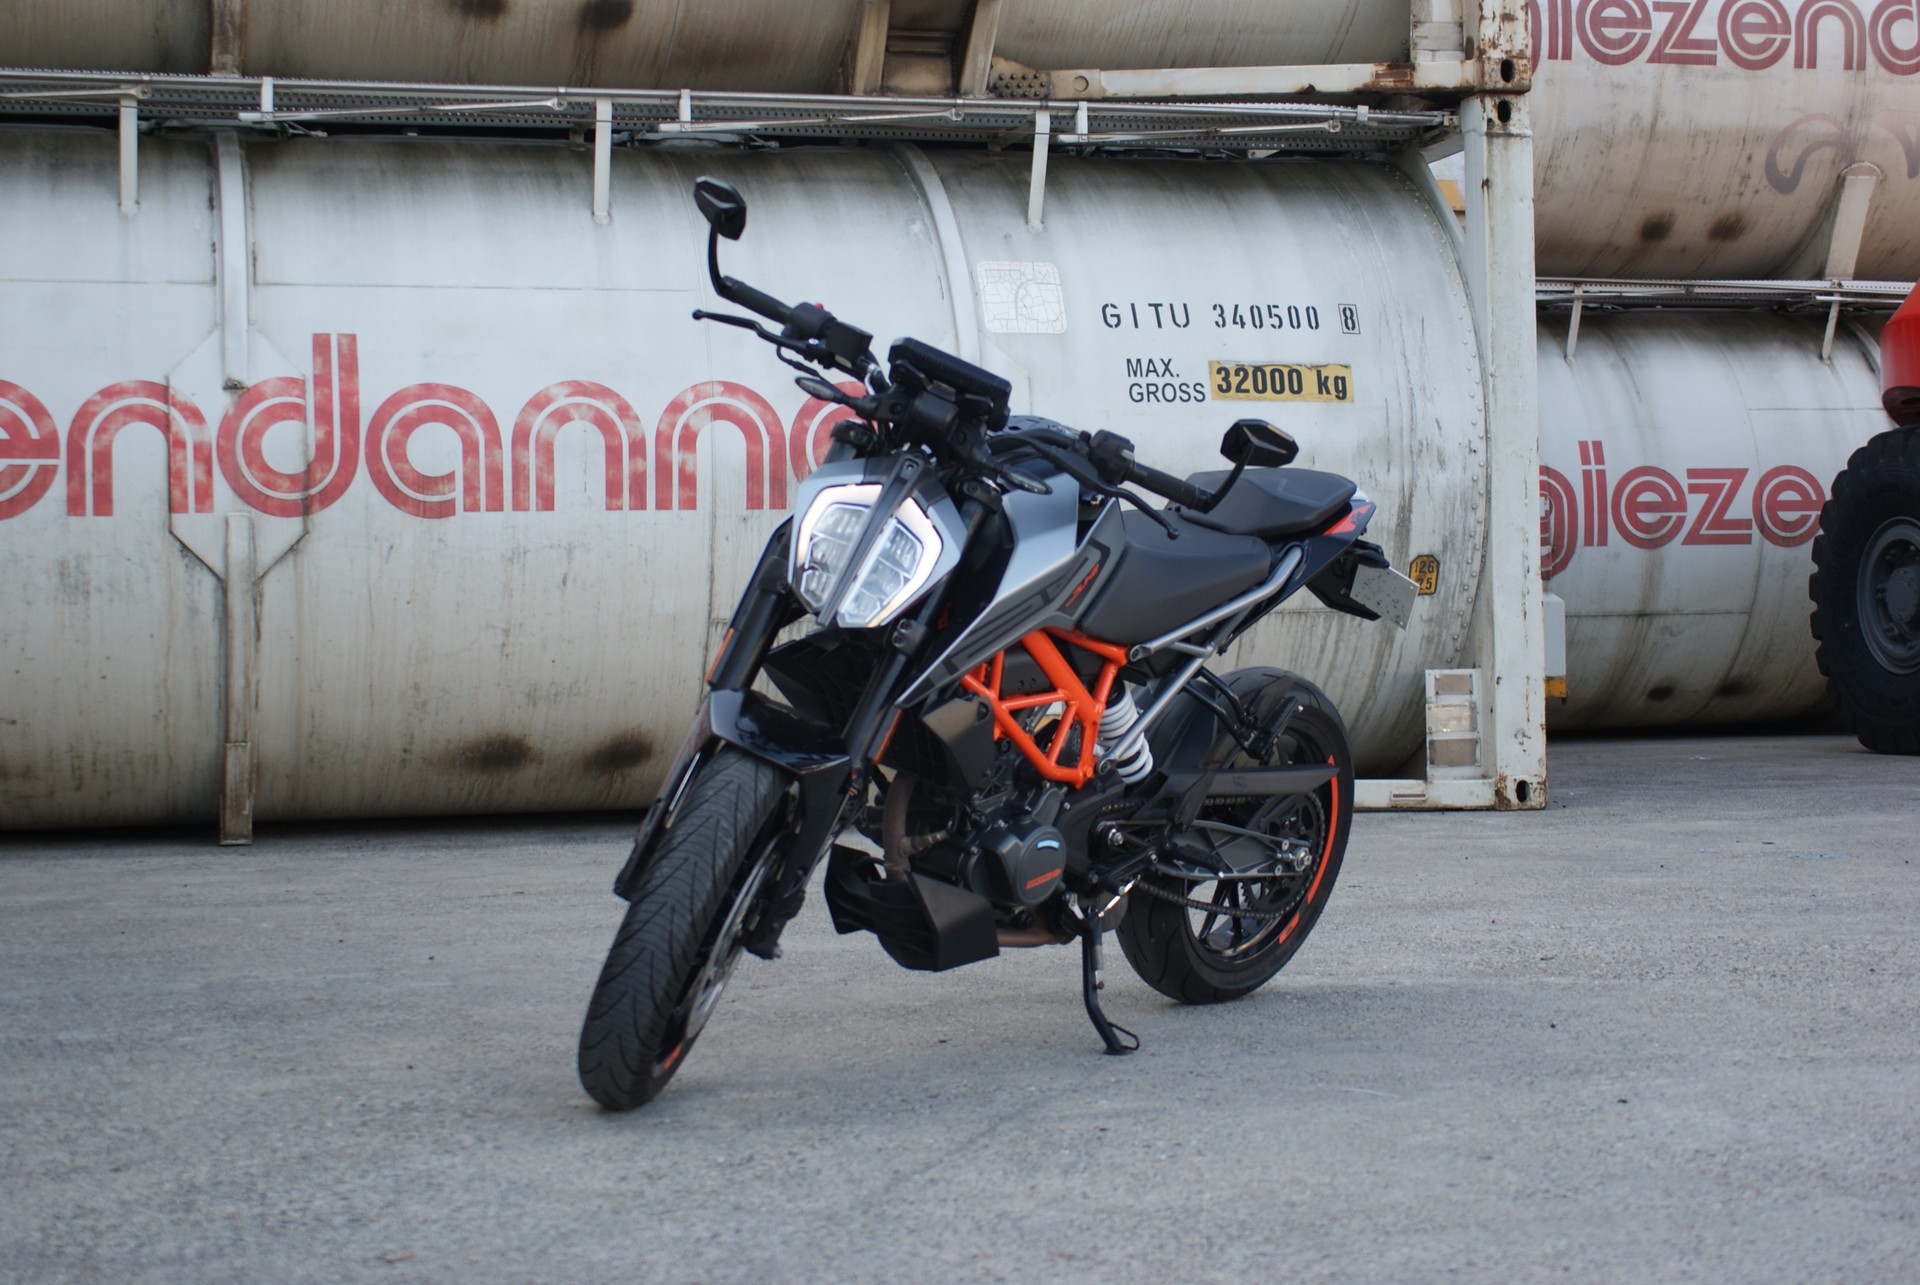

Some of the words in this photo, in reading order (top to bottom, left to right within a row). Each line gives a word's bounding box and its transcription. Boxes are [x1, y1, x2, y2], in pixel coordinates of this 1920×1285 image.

[1531, 0, 1920, 76] iezend
[1101, 302, 1190, 329] GITU
[1213, 302, 1320, 331] 340500
[1341, 305, 1358, 333] 8
[1125, 358, 1180, 378] MAX.
[1128, 382, 1207, 403] GROSS
[1215, 367, 1303, 395] 32000
[1316, 369, 1348, 400] kg
